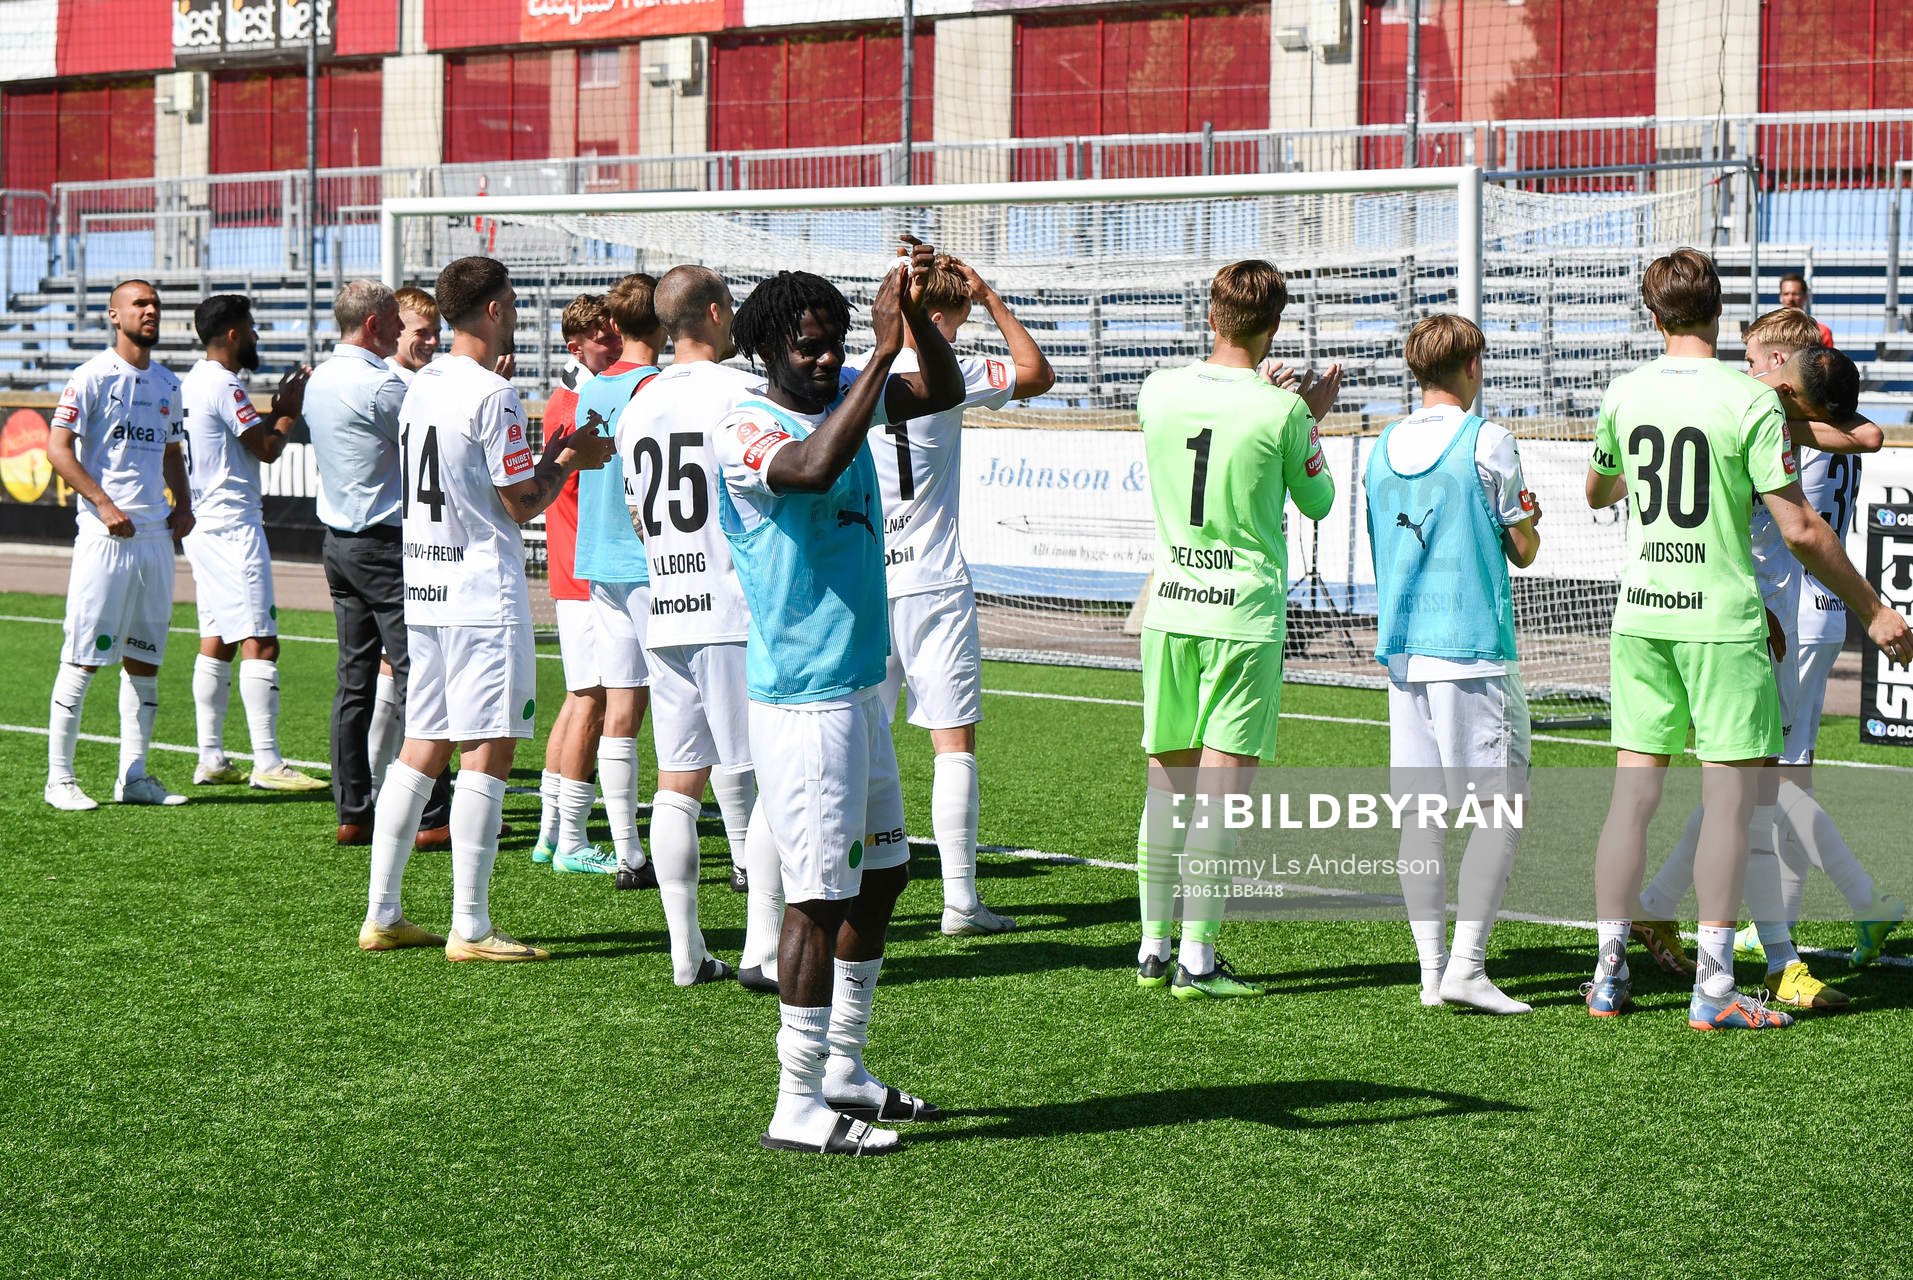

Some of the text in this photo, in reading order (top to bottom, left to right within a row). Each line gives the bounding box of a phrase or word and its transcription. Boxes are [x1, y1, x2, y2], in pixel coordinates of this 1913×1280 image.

[172, 0, 221, 47] best
[225, 0, 276, 43] best
[113, 422, 155, 442] akea
[401, 423, 446, 522] 14
[507, 452, 530, 467] UNIBET
[980, 456, 1147, 492] Johnson &
[633, 432, 709, 537] 25
[1186, 428, 1213, 527] 1
[1628, 424, 1710, 529] 30
[1157, 581, 1236, 607] tillmobil
[1626, 586, 1703, 610] tillmobil
[127, 636, 157, 653] RSA
[875, 827, 906, 847] RS
